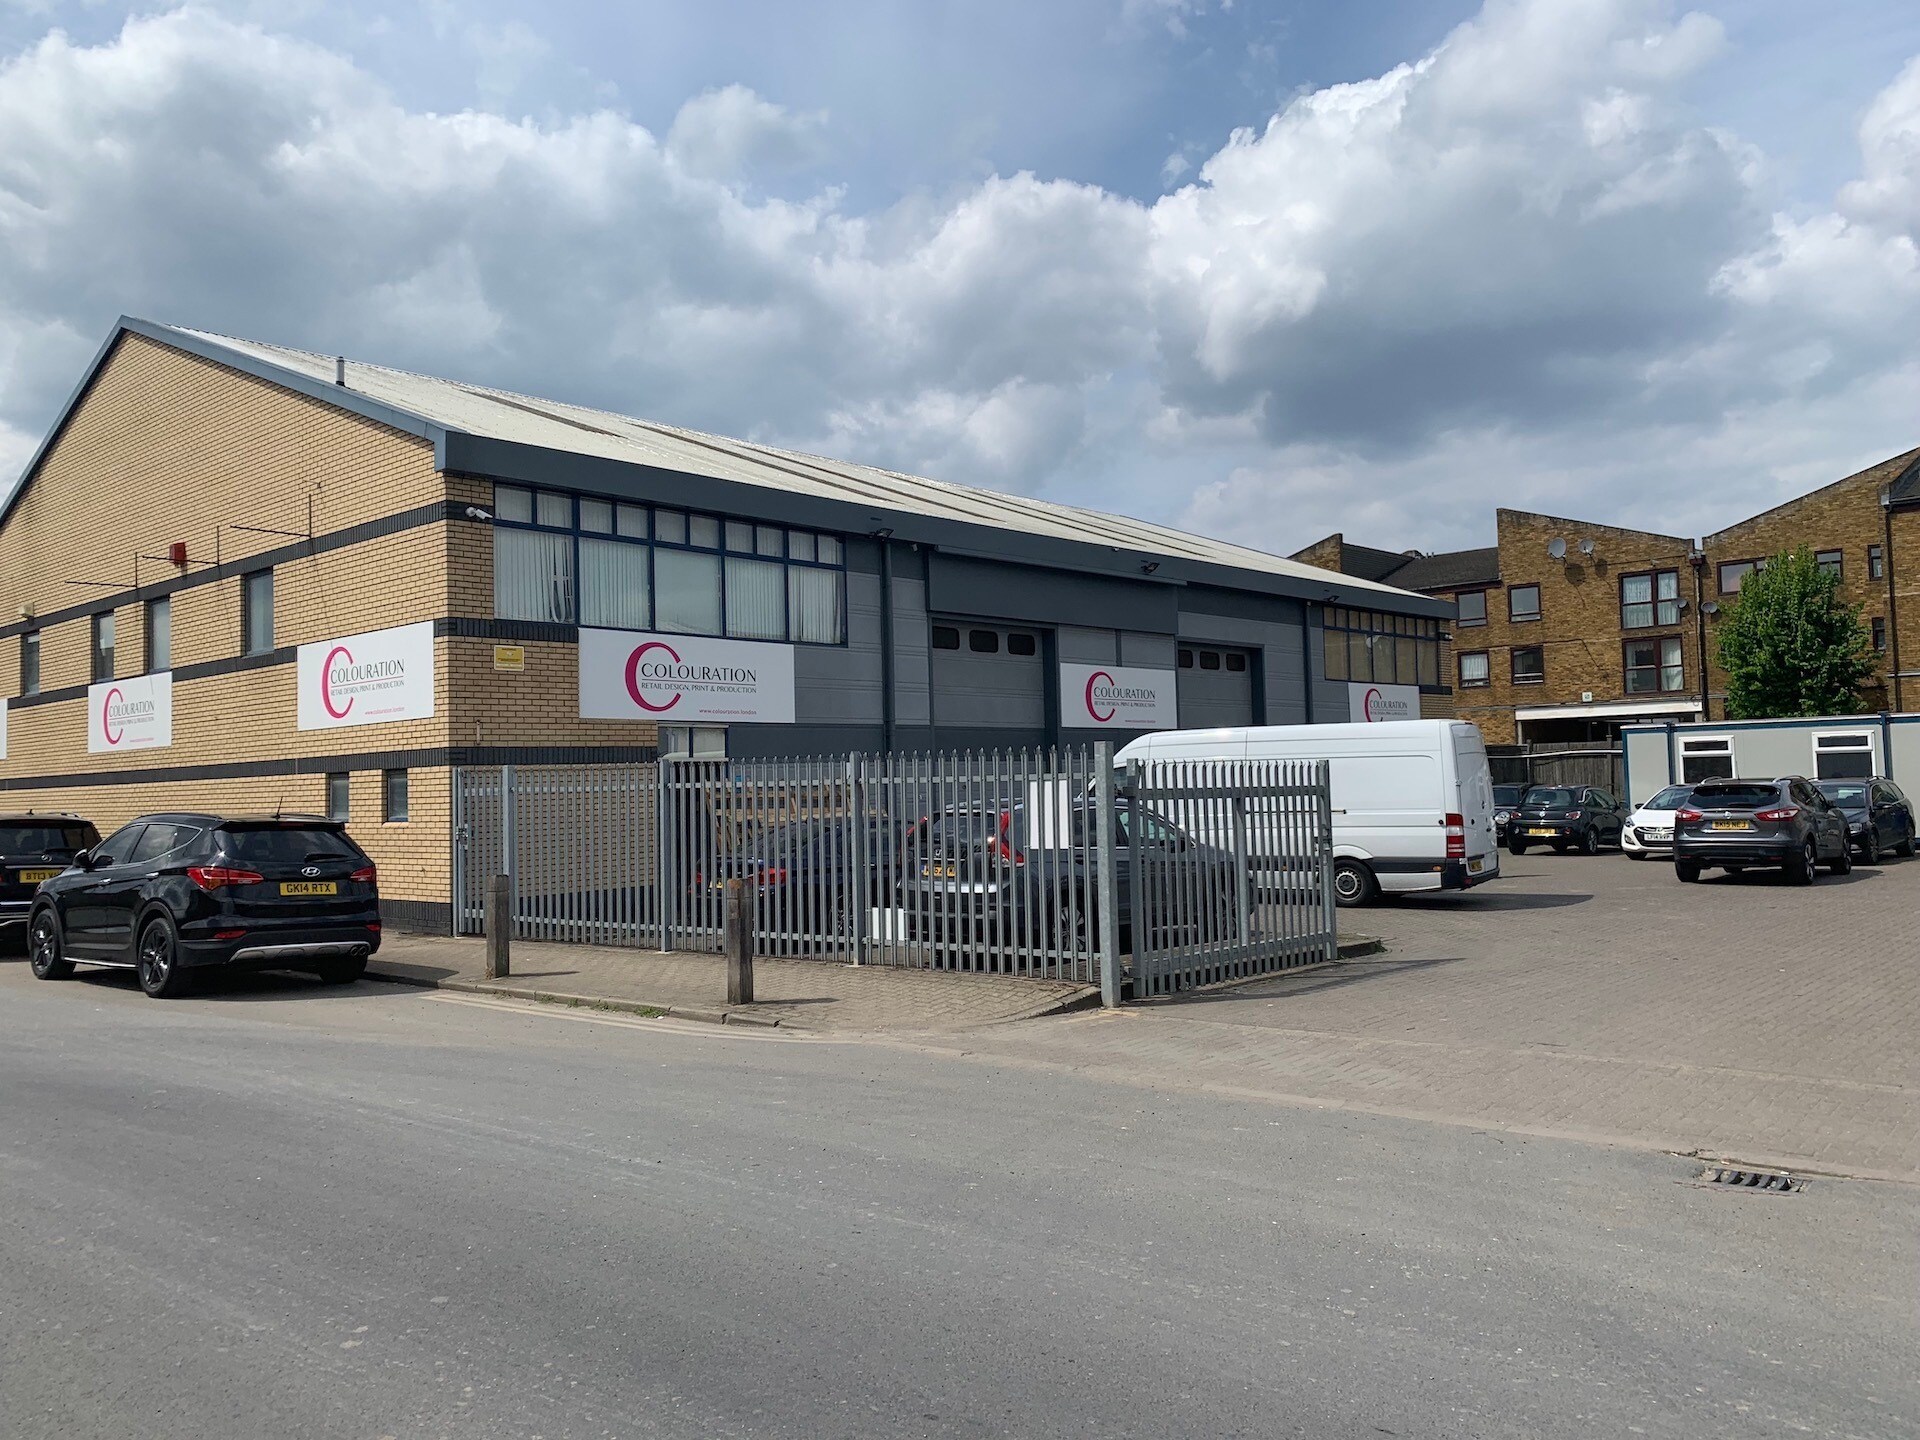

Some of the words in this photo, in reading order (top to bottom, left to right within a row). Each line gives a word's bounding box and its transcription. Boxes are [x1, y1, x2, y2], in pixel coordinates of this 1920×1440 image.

[330, 658, 405, 685] COLOURATION
[625, 642, 681, 712] C
[641, 663, 757, 683] COLOURATION
[321, 646, 354, 719] C
[641, 682, 663, 690] RETAIL
[664, 684, 690, 692] DESIGN,
[716, 686, 757, 694] PRODUCTION
[1085, 671, 1116, 722] C
[1093, 686, 1156, 700] COLOURATION
[108, 700, 155, 718] COLOURATION
[1369, 699, 1408, 709] COLOURATION
[103, 688, 124, 745] C
[286, 883, 310, 893] GK14
[311, 883, 331, 893] RTX
